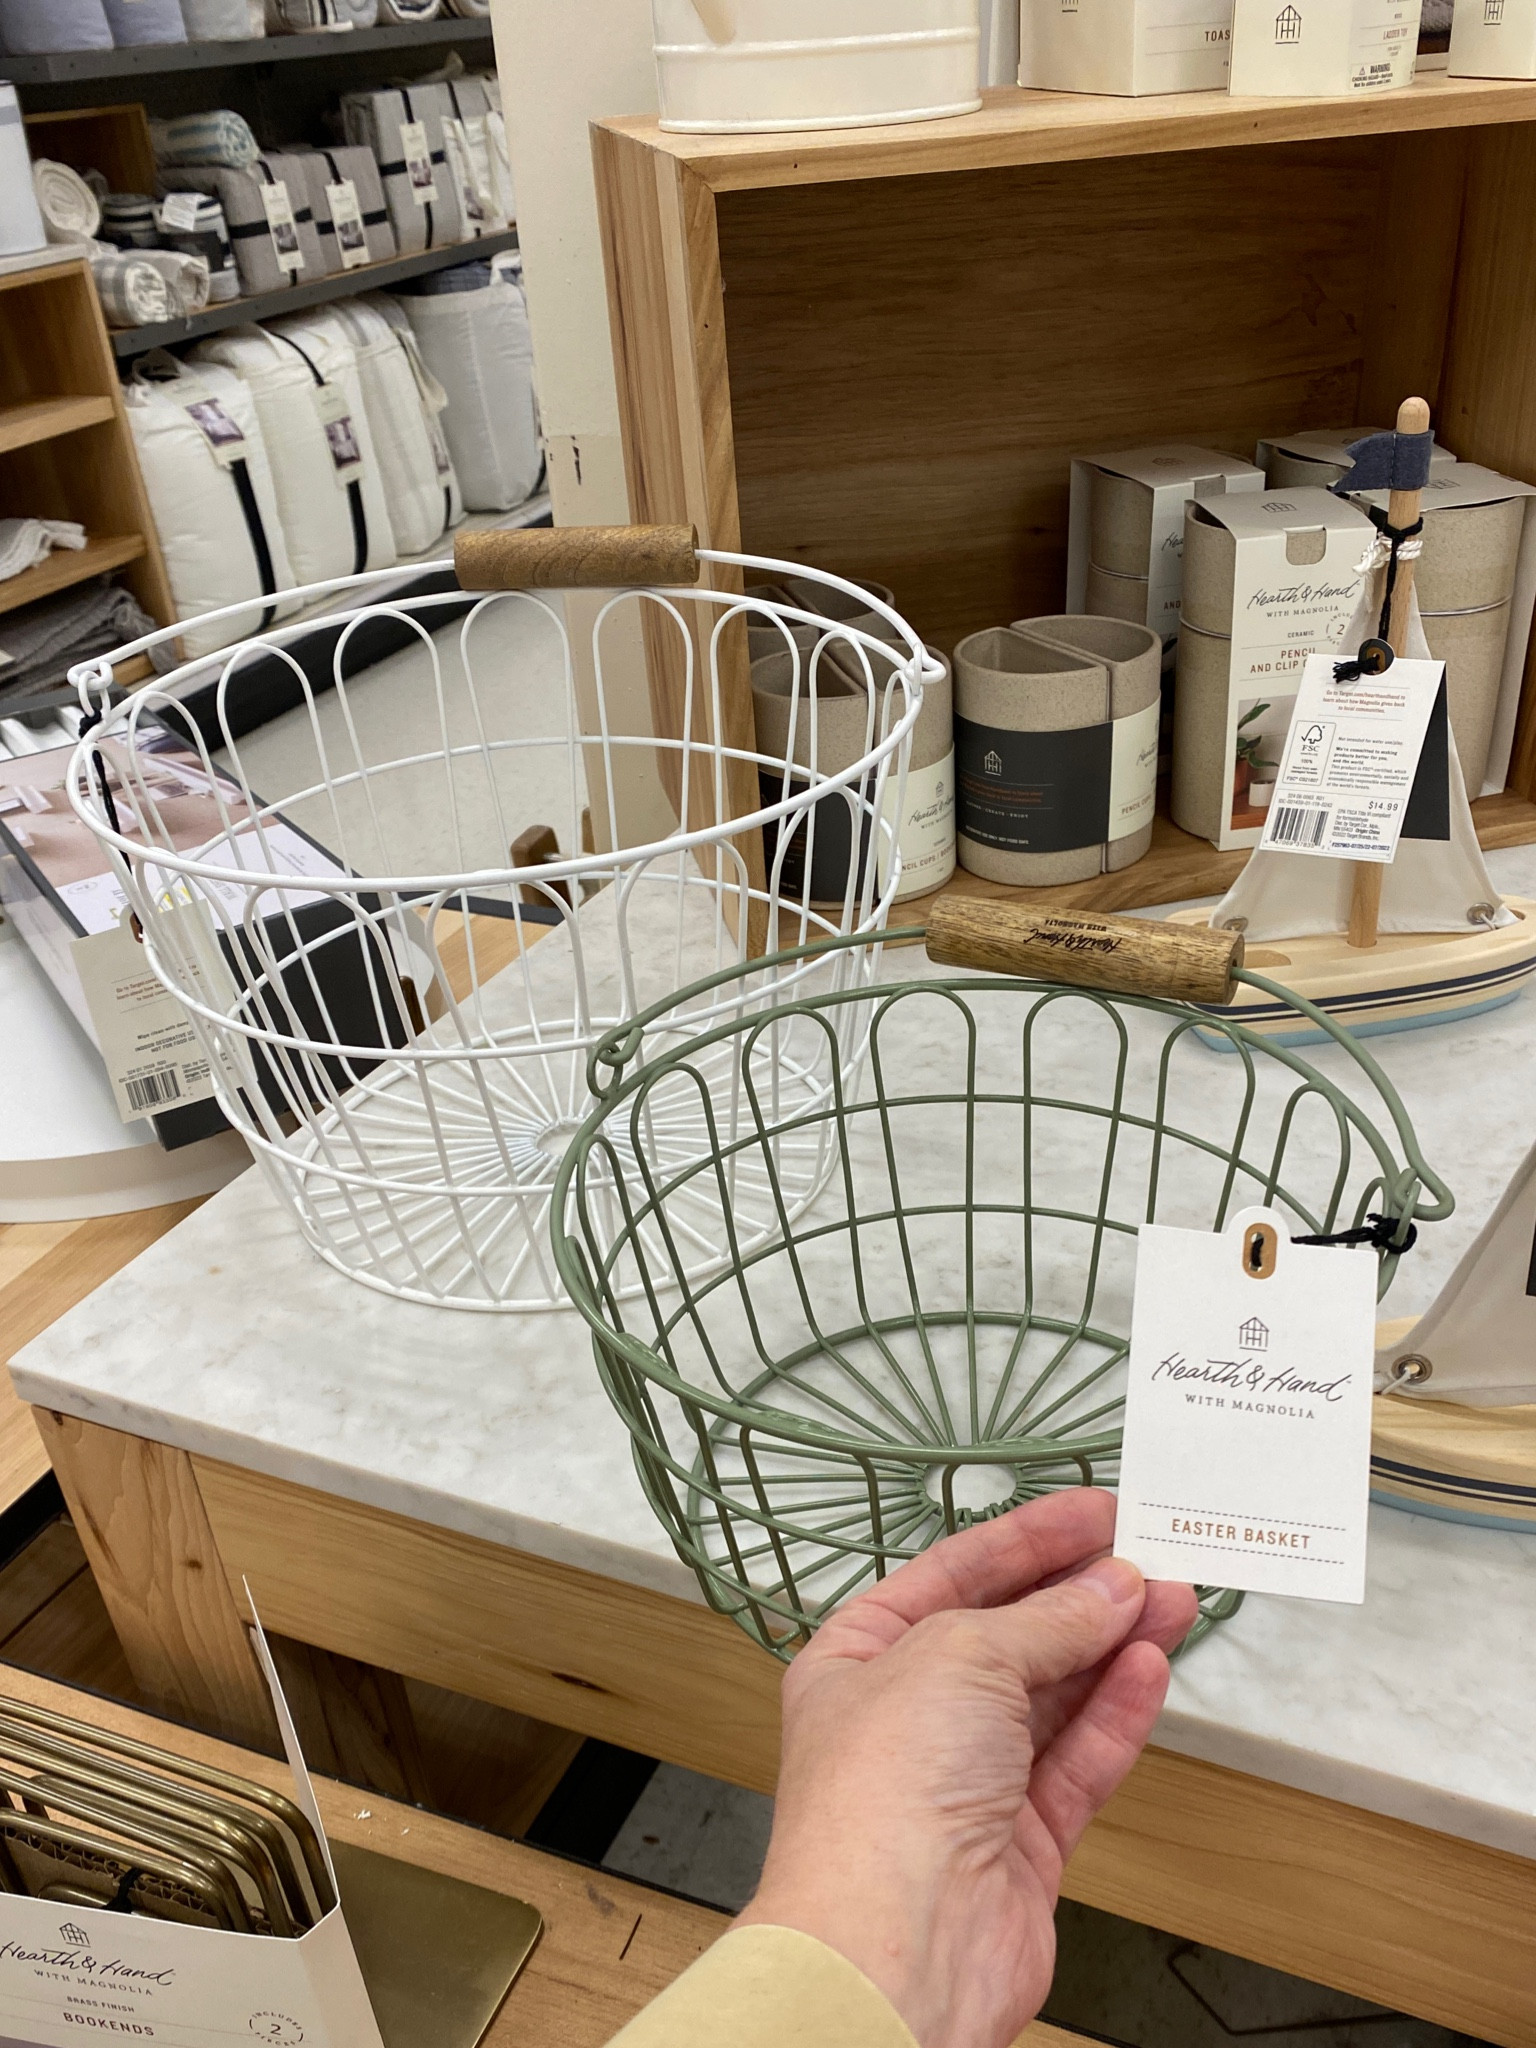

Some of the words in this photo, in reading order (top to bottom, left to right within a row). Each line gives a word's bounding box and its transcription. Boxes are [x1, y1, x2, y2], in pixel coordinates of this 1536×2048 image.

[1205, 30, 1230, 42] TOAS
[1161, 531, 1184, 551] Hea
[1246, 582, 1305, 610] Hearth
[1301, 586, 1312, 603] &
[1311, 579, 1360, 602] Hand
[1164, 600, 1181, 610] AND
[1266, 609, 1290, 618] WITH
[1293, 605, 1339, 616] MAGNOLIA
[1287, 630, 1315, 638] CERAMIC
[1336, 623, 1345, 635] 2
[1250, 663, 1271, 673] AND
[1275, 661, 1299, 671] CLIP
[1368, 800, 1399, 811] $14.99
[902, 862, 918, 872] NCIL
[920, 855, 936, 866] CUPS
[1152, 1352, 1252, 1389] Hearth
[1246, 1365, 1264, 1391] &
[1262, 1366, 1352, 1402] Hand
[1185, 1393, 1225, 1408] WITH
[1231, 1400, 1315, 1420] MAGNOLIA
[1171, 1518, 1237, 1540] EASTER
[1243, 1527, 1311, 1550] BASKET
[0, 1941, 81, 1970] Hearth
[81, 1955, 97, 1973] &
[99, 1959, 175, 1986] Hand
[34, 1969, 71, 1982] WITH
[77, 1977, 153, 1996] MAGNOLIA
[66, 1995, 98, 2008] BRASS
[101, 2001, 135, 2013] FINISH
[63, 2012, 155, 2036] BOOKENDS
[270, 2023, 281, 2036] 2
